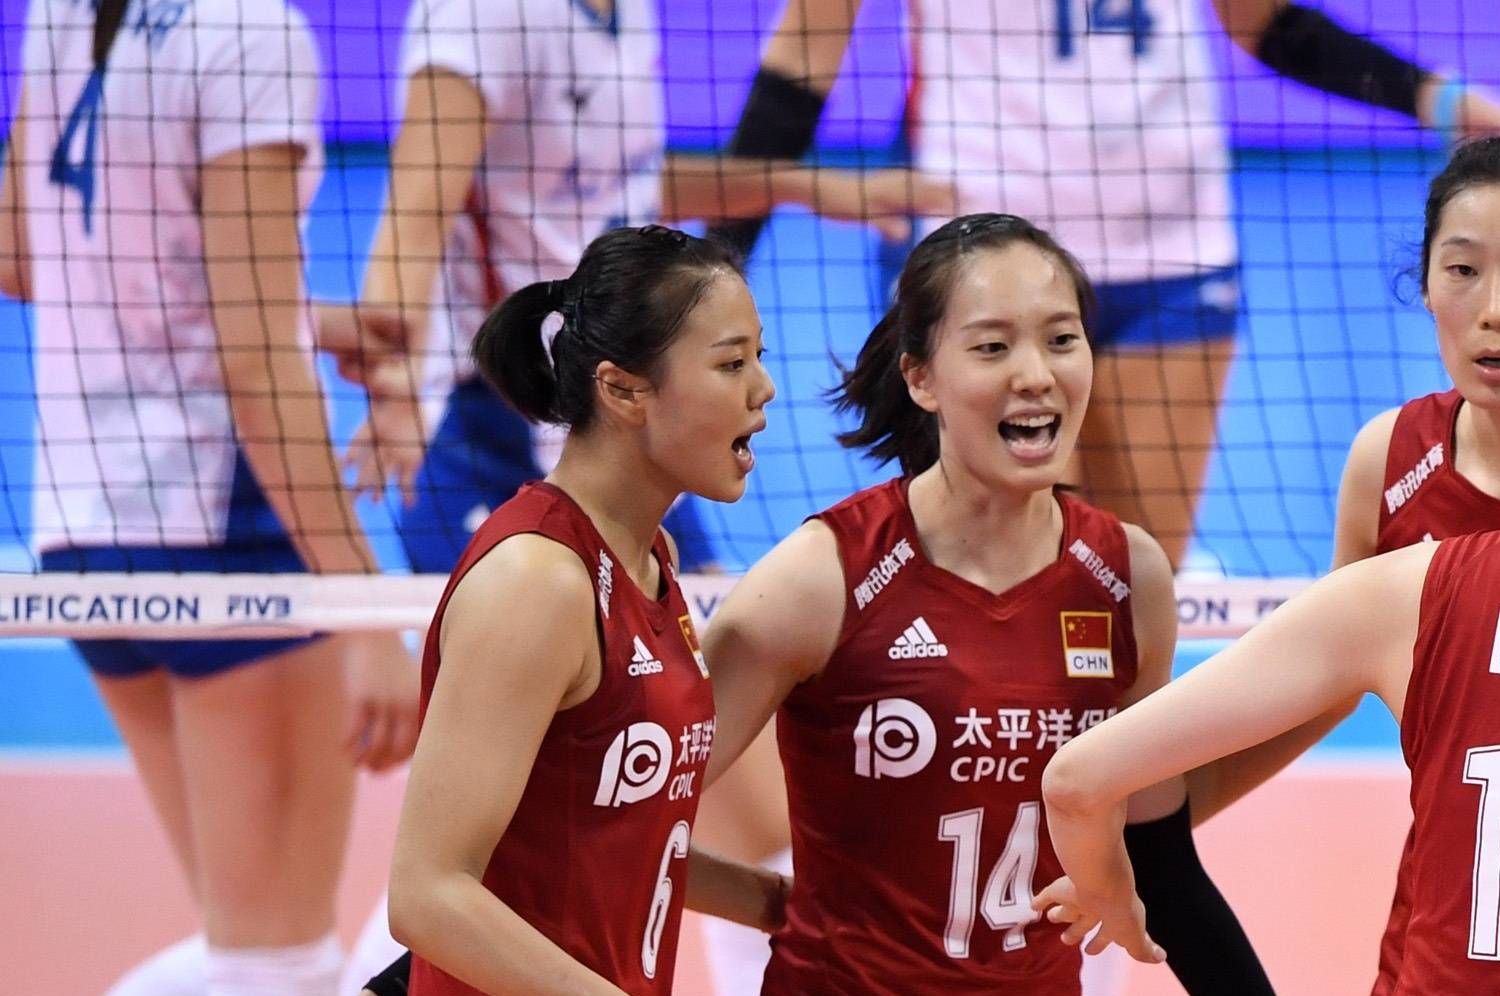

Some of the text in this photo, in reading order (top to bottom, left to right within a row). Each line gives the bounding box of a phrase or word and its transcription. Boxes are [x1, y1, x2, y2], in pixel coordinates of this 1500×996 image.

[888, 642, 948, 660] adidas
[1073, 654, 1108, 670] CHN
[949, 757, 1030, 783] CPIC
[668, 771, 697, 801] CPIC
[937, 801, 1041, 959] 14
[641, 820, 691, 979] 6
